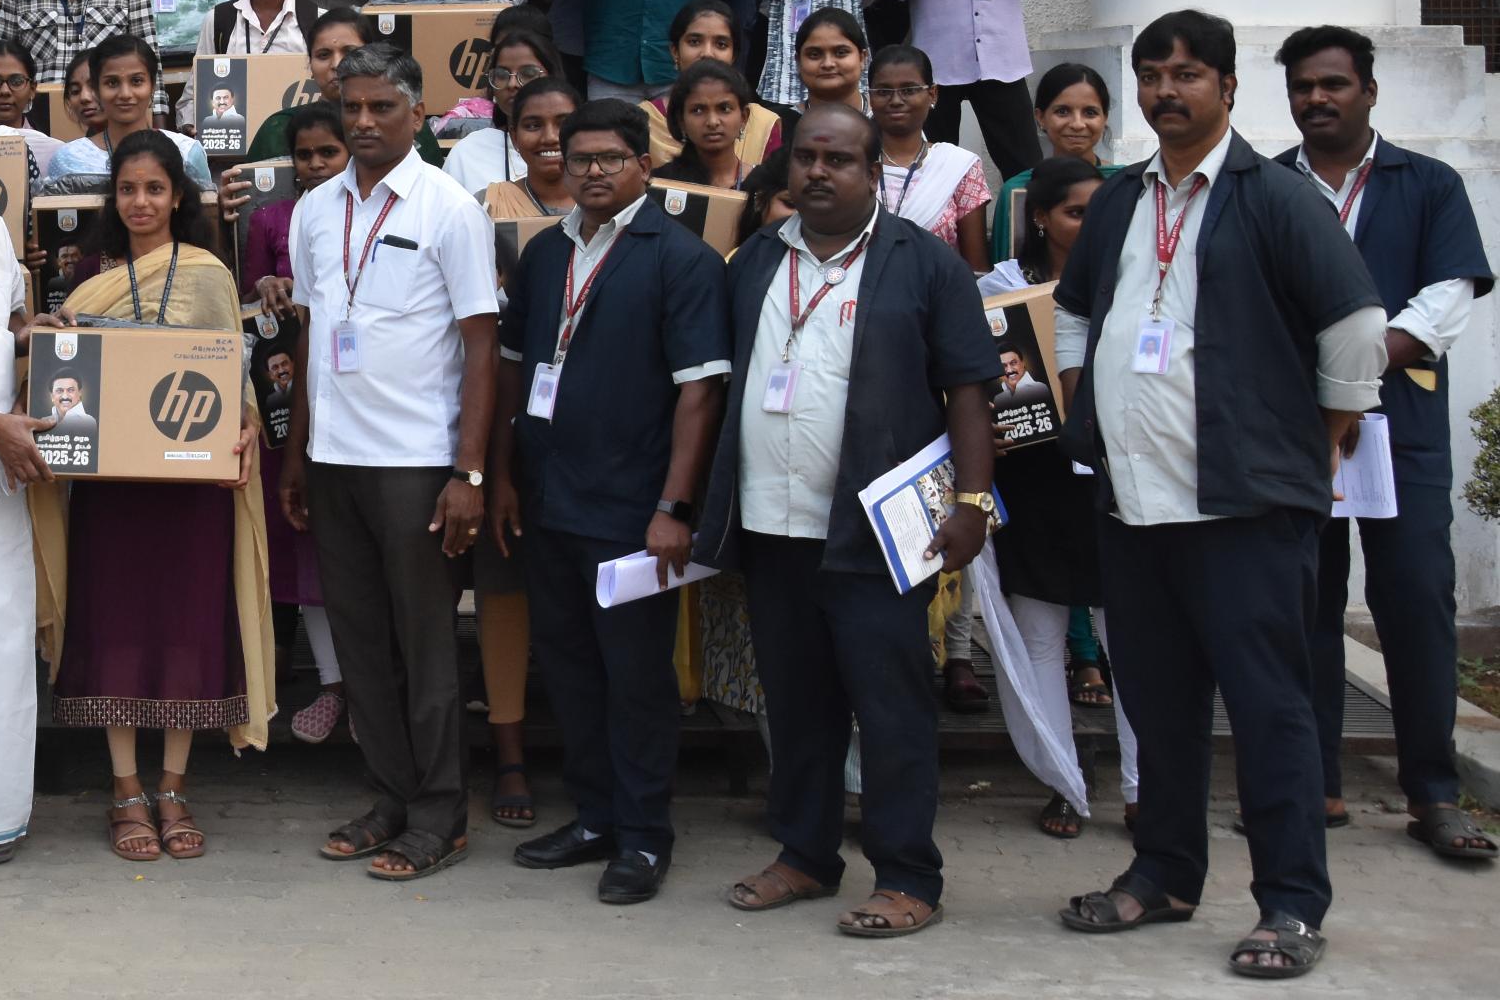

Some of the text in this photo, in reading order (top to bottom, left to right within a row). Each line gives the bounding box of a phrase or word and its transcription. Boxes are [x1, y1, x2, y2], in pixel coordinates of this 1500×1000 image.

[203, 139, 240, 149] 2025-26
[157, 370, 215, 442] hp
[998, 406, 1028, 419] தமிழ்நாடு
